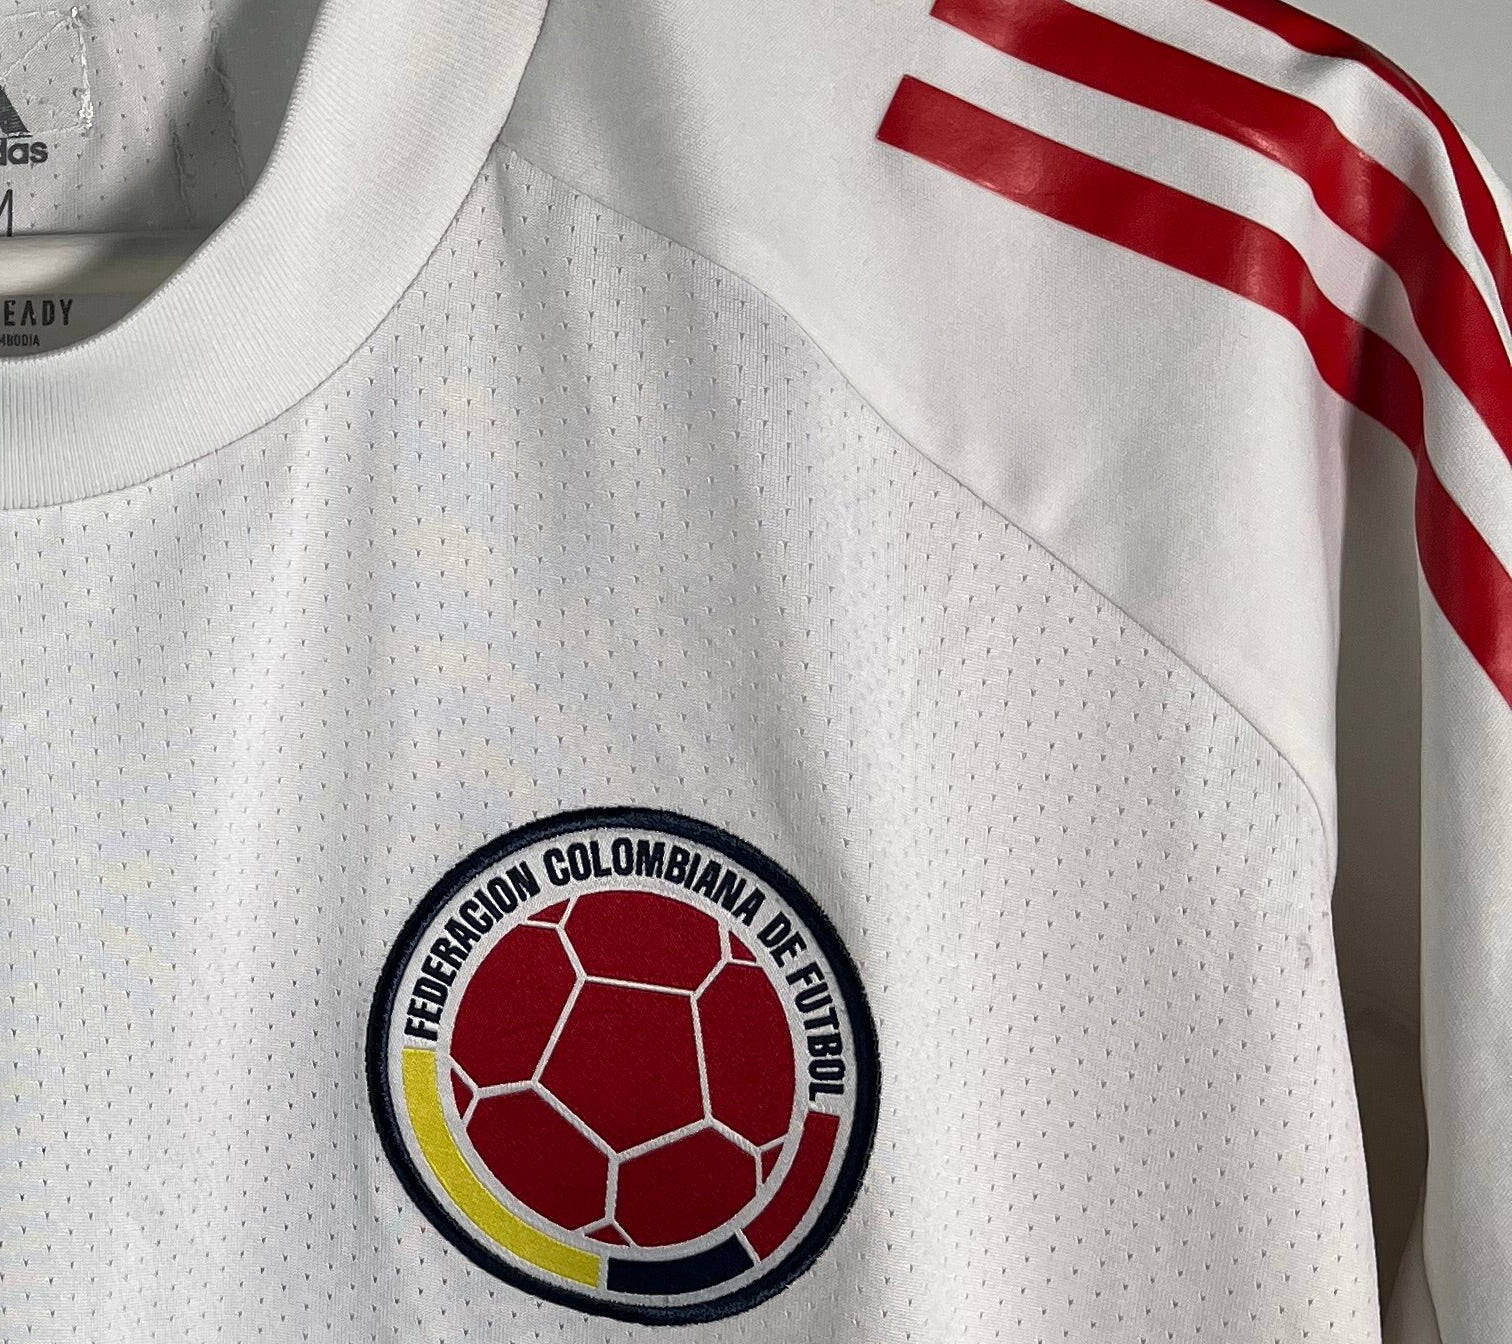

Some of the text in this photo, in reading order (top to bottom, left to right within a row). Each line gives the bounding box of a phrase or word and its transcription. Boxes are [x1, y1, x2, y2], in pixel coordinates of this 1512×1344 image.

[403, 836, 846, 1103] FEDERACION COLOMBIANA DE FUTBOL
